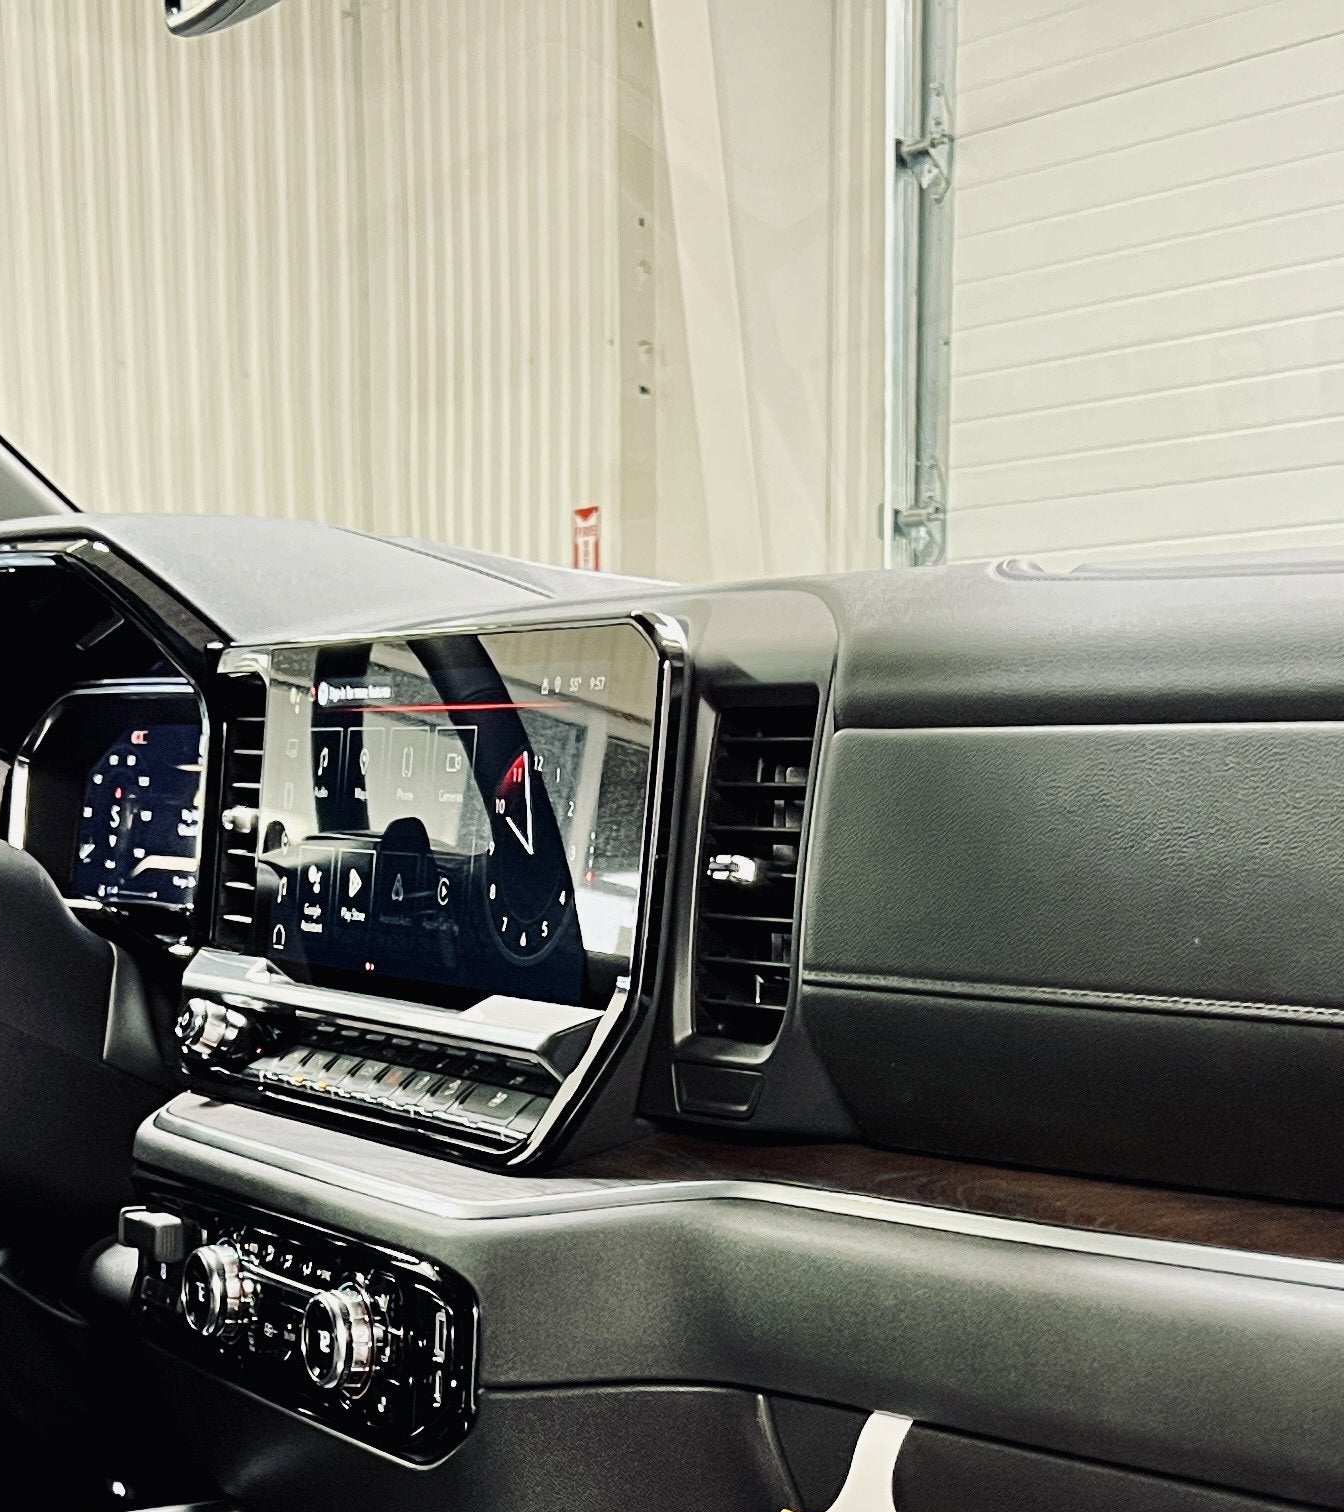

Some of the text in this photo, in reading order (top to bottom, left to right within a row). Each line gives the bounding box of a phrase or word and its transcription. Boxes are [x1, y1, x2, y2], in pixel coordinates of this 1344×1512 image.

[533, 755, 544, 772] 12
[513, 767, 523, 782] 11
[556, 767, 561, 783] 1
[495, 798, 505, 814] 10
[567, 801, 575, 817] 2
[488, 840, 495, 856] 9
[558, 890, 566, 905] 4
[501, 916, 508, 932] 7
[541, 920, 548, 937] 5
